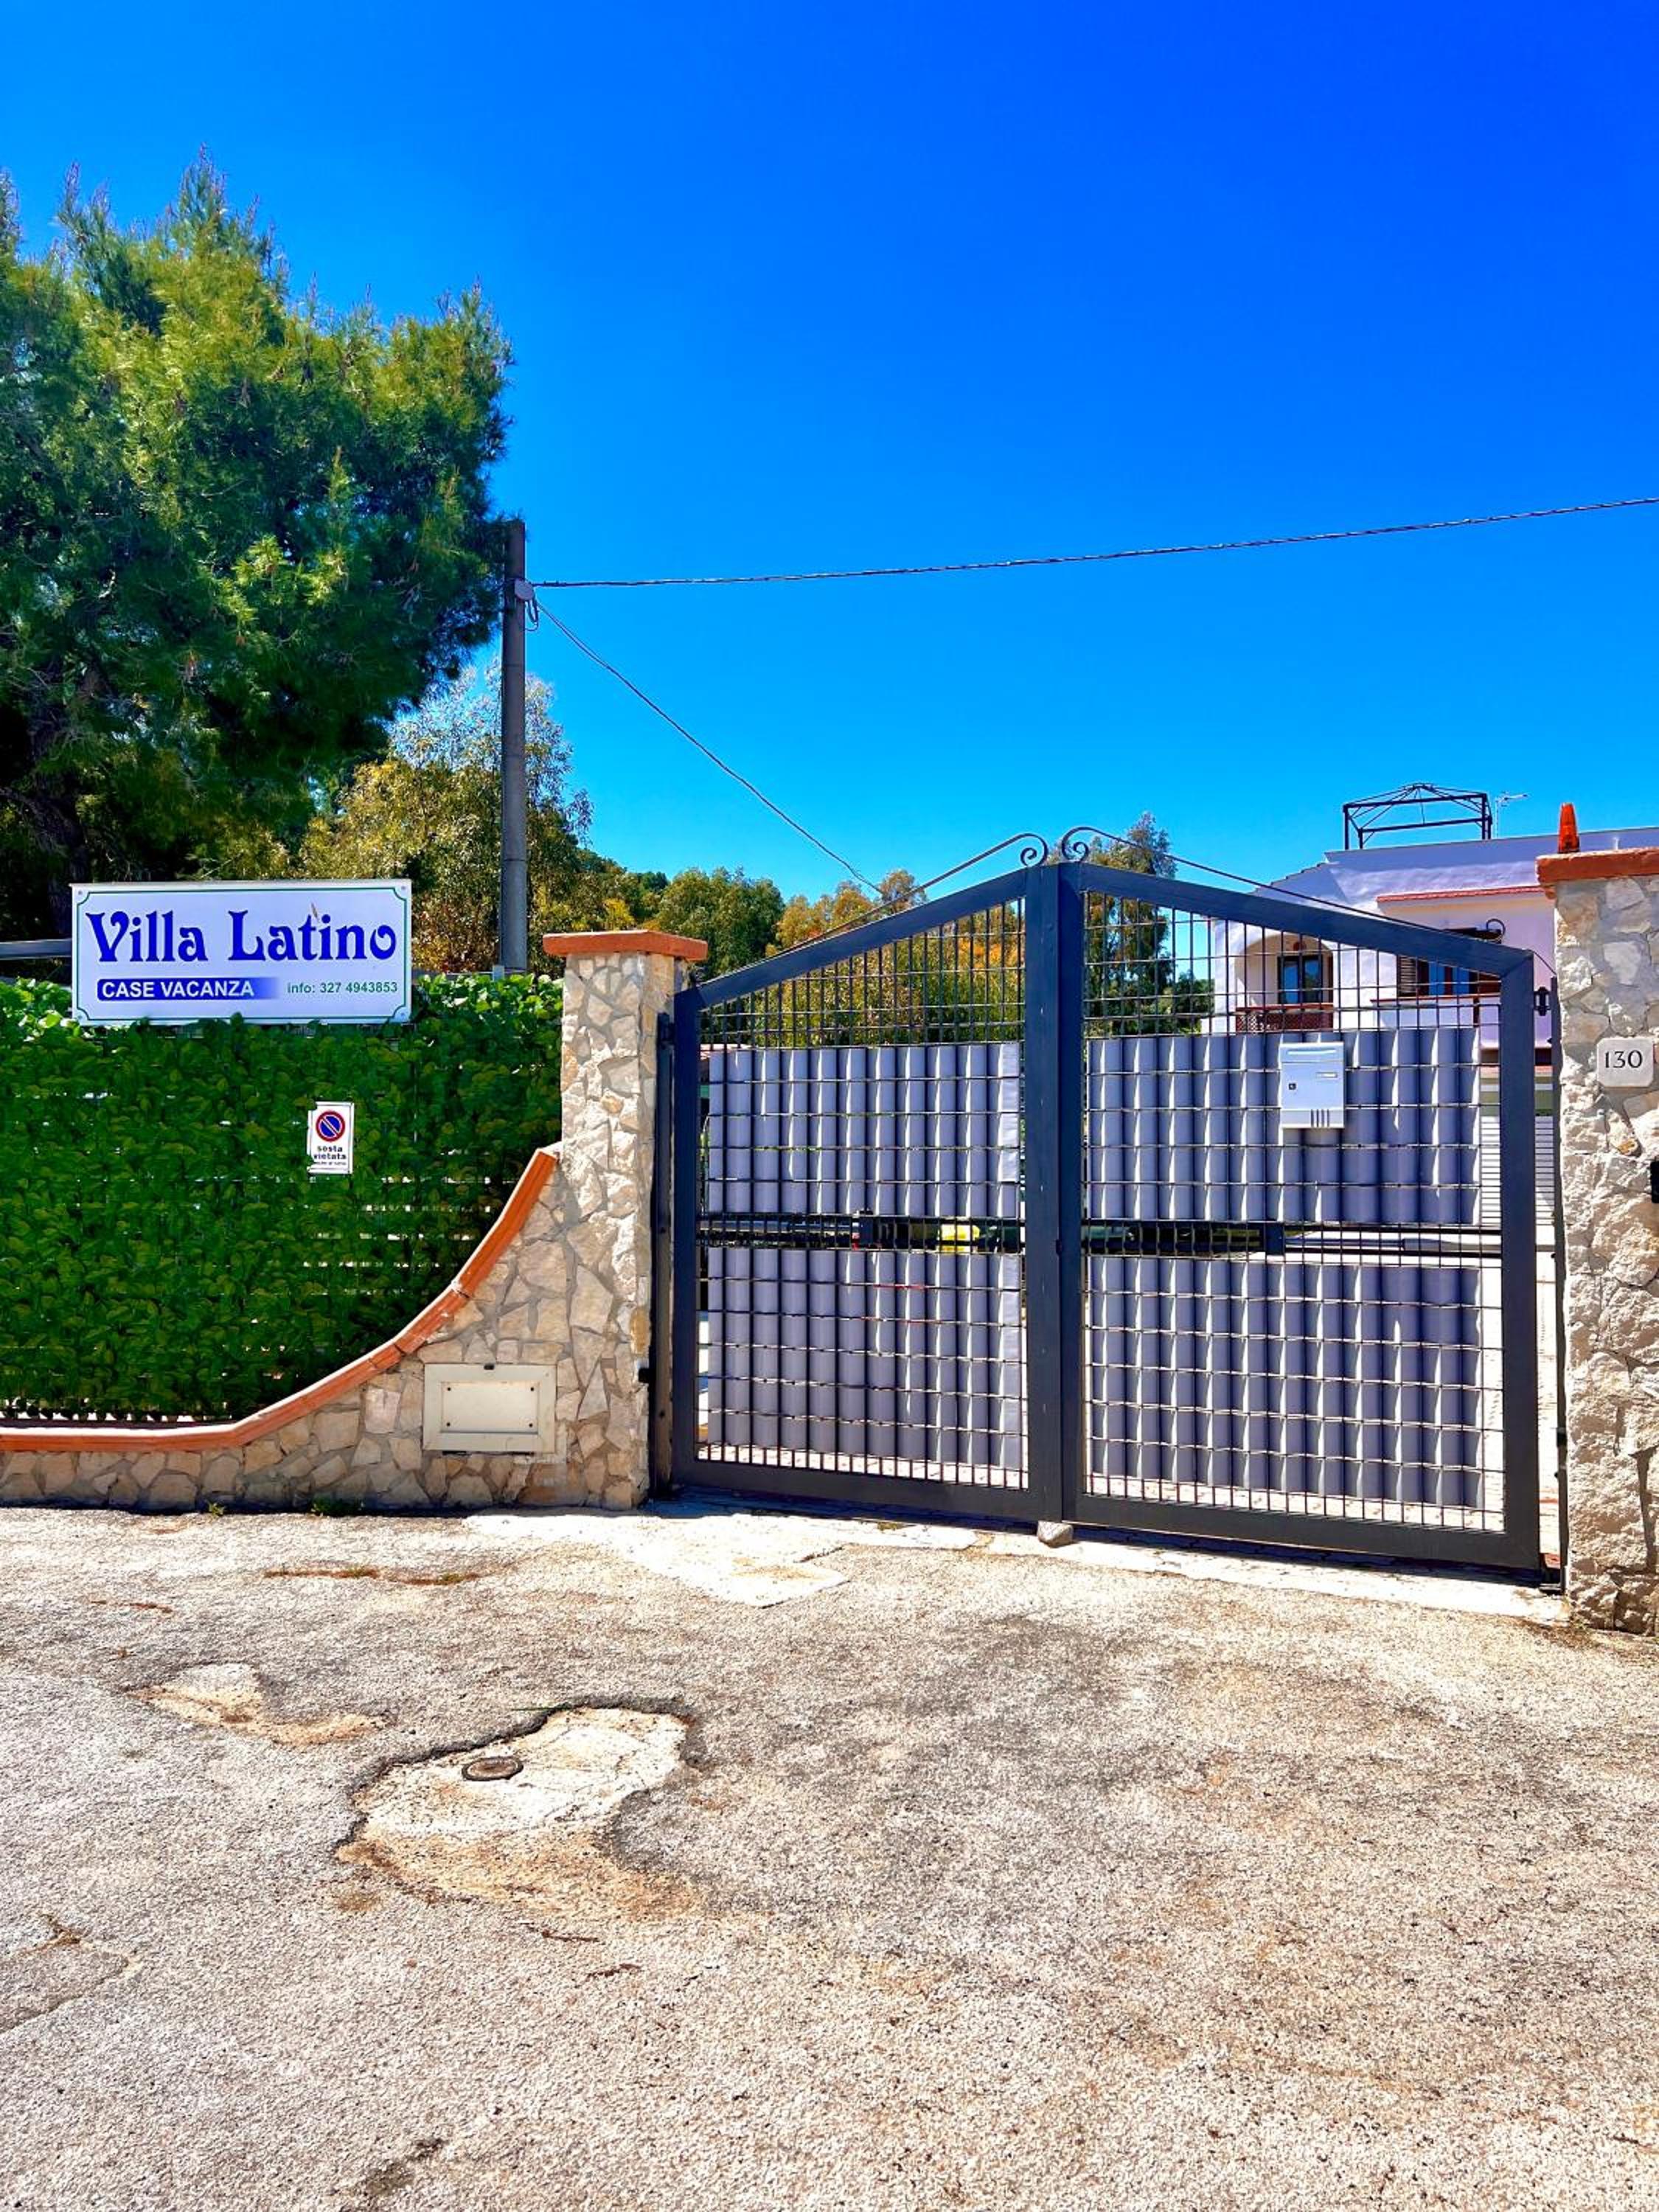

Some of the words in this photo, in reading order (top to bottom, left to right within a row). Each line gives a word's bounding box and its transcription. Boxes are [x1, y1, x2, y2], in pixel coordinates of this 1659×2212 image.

[86, 910, 209, 961] Villa
[228, 910, 397, 961] Latino
[102, 981, 154, 998] CASE
[160, 980, 254, 997] VACANZA
[288, 982, 316, 993] info:
[319, 982, 341, 993] 327
[345, 981, 398, 993] 4943853
[1604, 1049, 1644, 1068] 130
[317, 1144, 343, 1152] sosta
